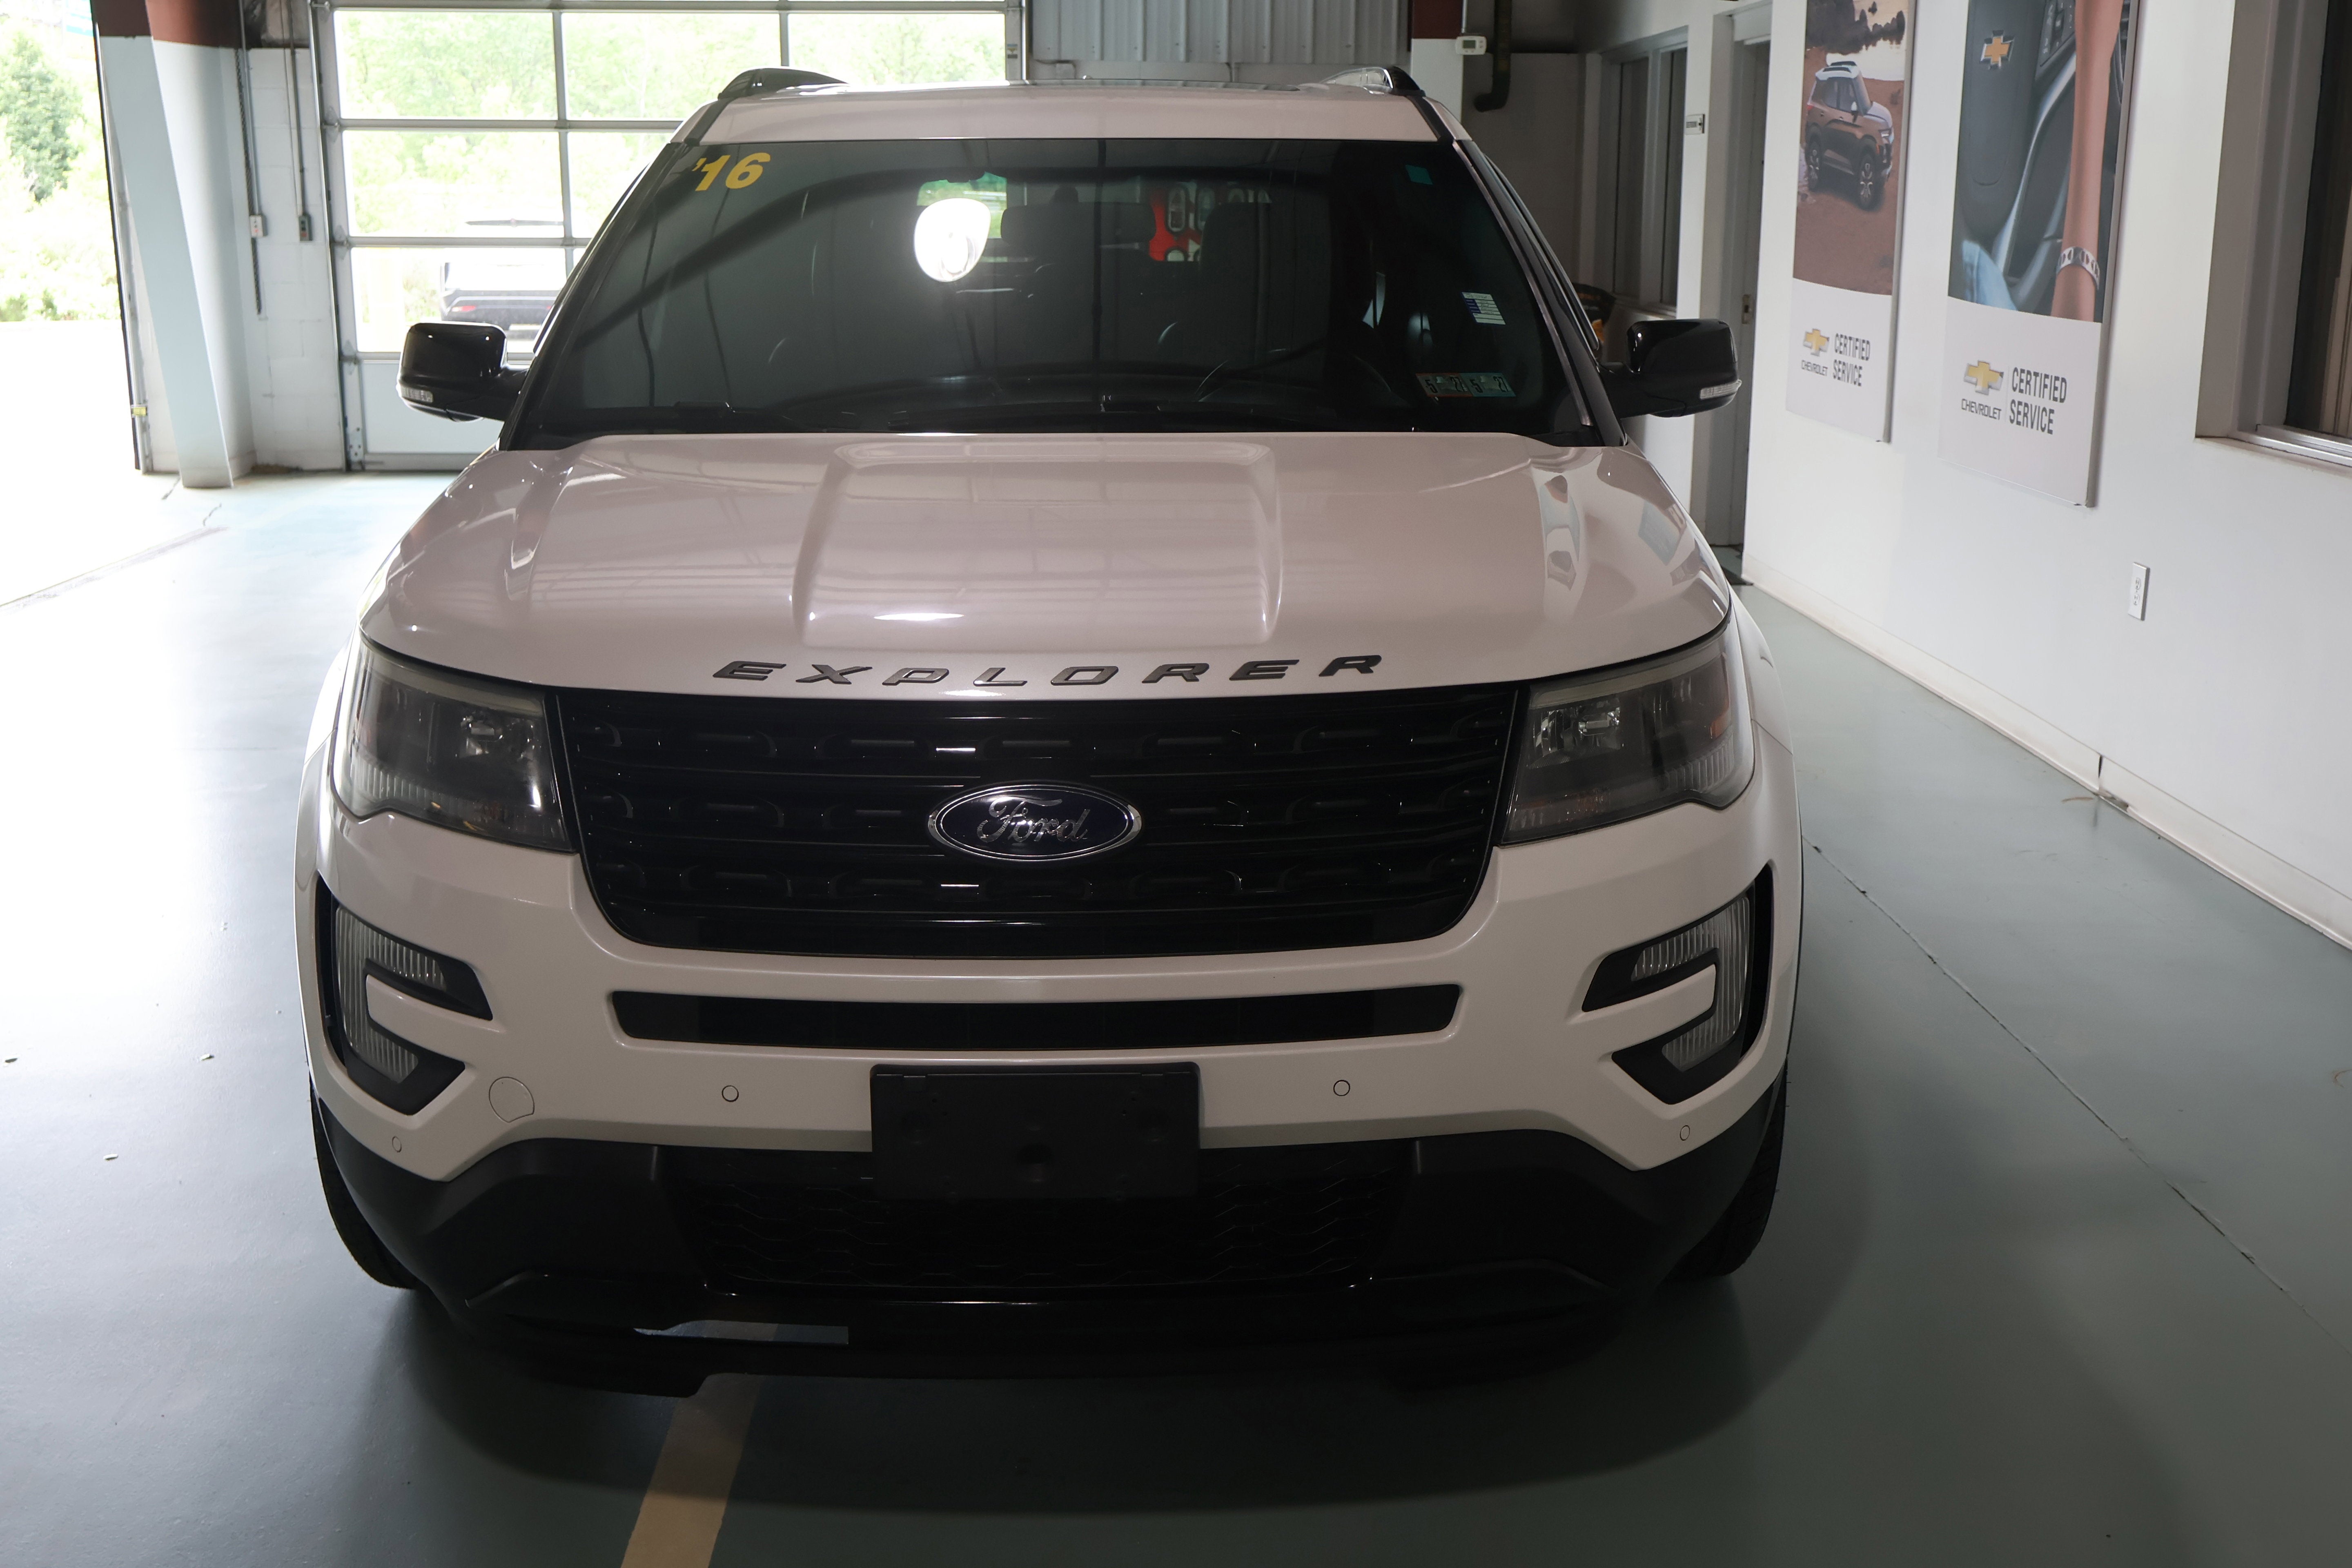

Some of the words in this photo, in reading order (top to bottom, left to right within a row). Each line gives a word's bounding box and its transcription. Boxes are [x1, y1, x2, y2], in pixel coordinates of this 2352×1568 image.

[691, 152, 771, 192] '16
[1834, 333, 1871, 361] CERTIFIED
[1801, 360, 1829, 376] CHEVROLET
[1833, 359, 1863, 387] SERVICE
[1425, 379, 1438, 394] 5
[1470, 379, 1483, 393] 5
[2011, 367, 2067, 403] CERTIFIED
[1961, 398, 2002, 421] CHEVROLET
[2009, 399, 2055, 435] SERVICE
[713, 655, 1383, 688] EXPLORER
[976, 795, 1091, 843] Ford
